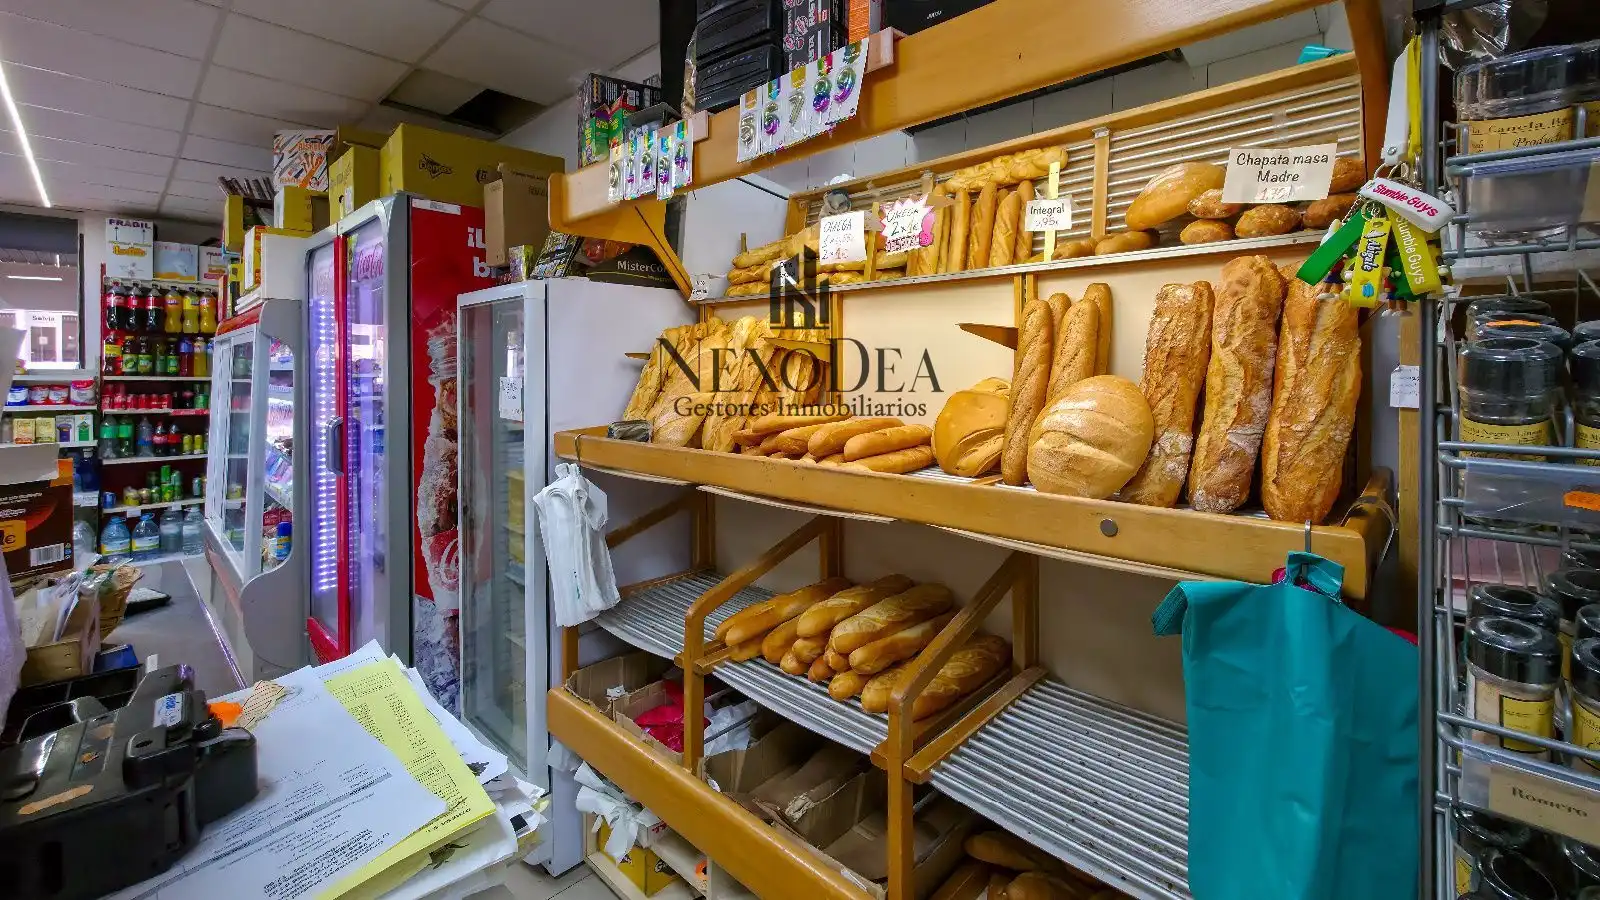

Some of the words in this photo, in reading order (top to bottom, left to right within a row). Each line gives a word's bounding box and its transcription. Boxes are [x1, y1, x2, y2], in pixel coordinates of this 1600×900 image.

[1235, 152, 1290, 171] Chapata
[1292, 154, 1329, 165] masa
[1257, 169, 1300, 184] Madre
[1030, 202, 1065, 217] Integral
[1372, 184, 1409, 202] Stumble
[1407, 196, 1439, 217] Guys
[886, 206, 920, 222] OMEGA
[1407, 253, 1426, 285] Guys
[1511, 786, 1589, 818] Romero
